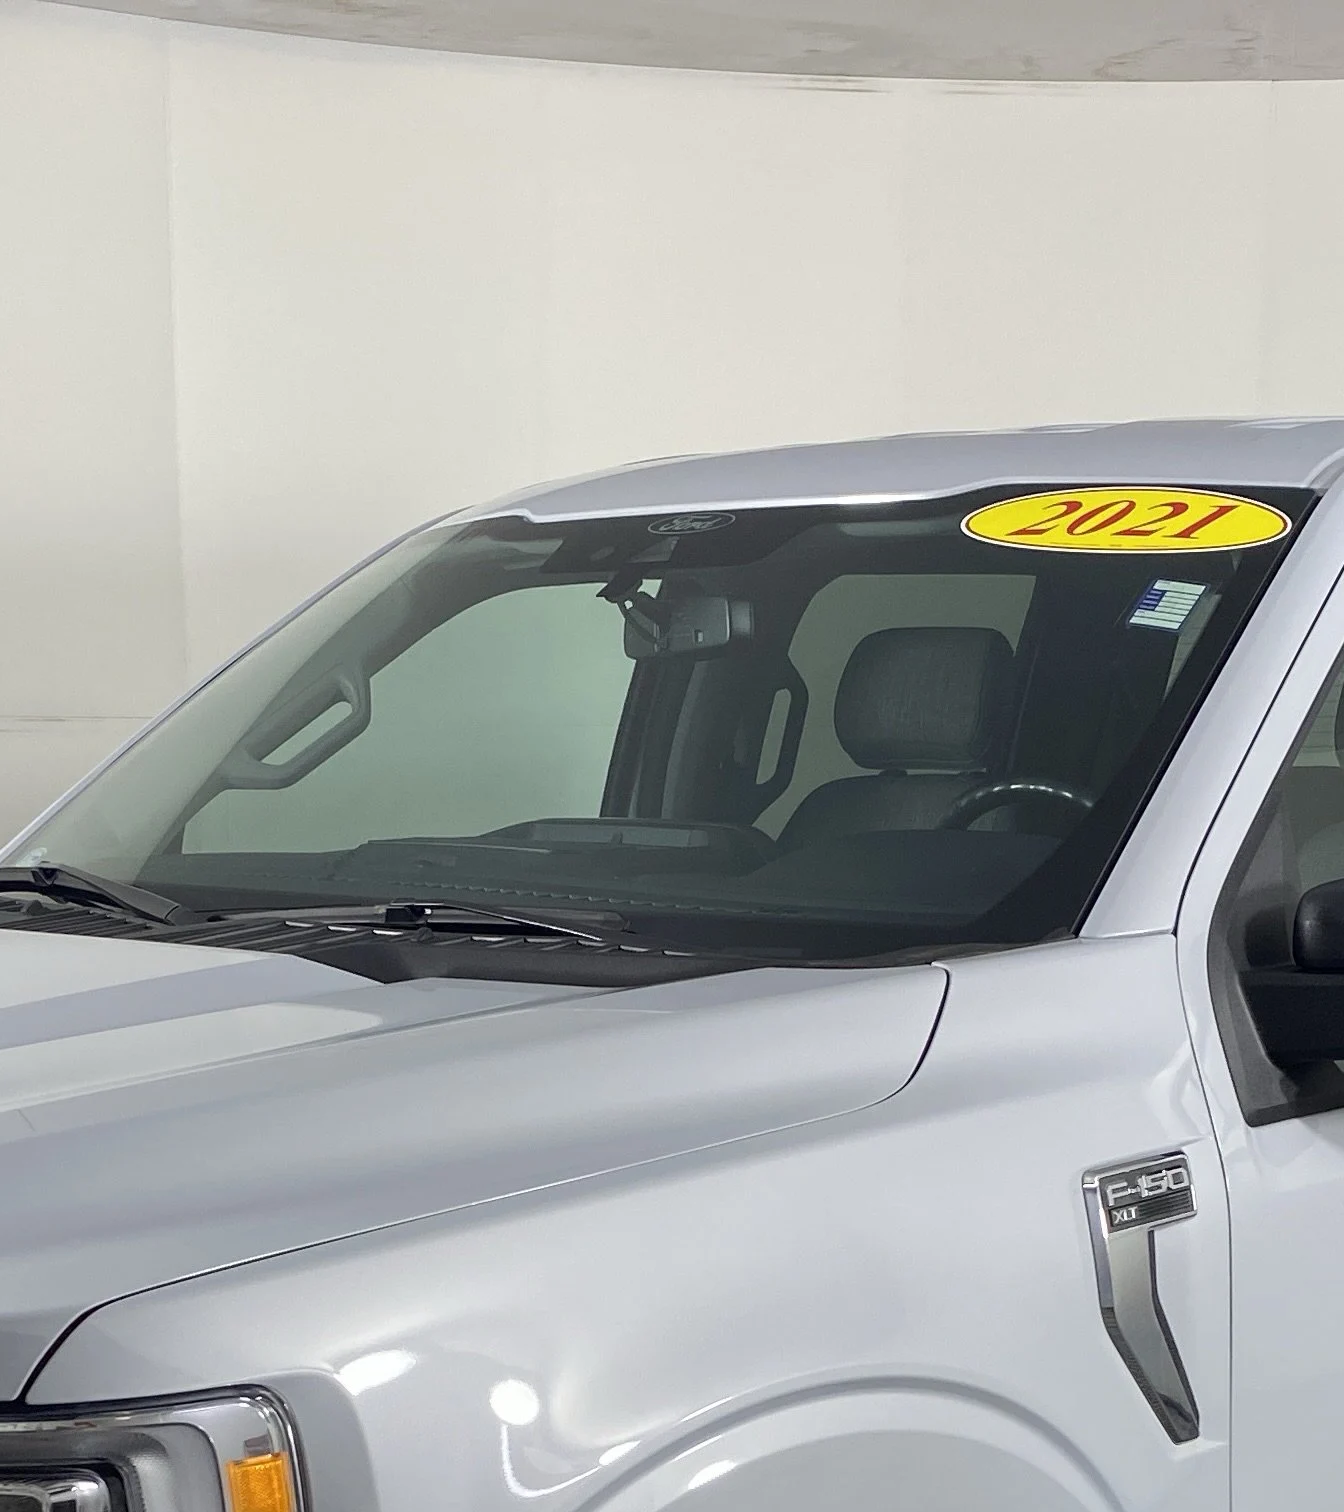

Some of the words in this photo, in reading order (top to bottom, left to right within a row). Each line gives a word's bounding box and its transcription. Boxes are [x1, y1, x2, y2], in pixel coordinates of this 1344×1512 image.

[1005, 499, 1239, 540] 2021
[1106, 1167, 1191, 1207] F-150
[1112, 1206, 1139, 1225] XLT
